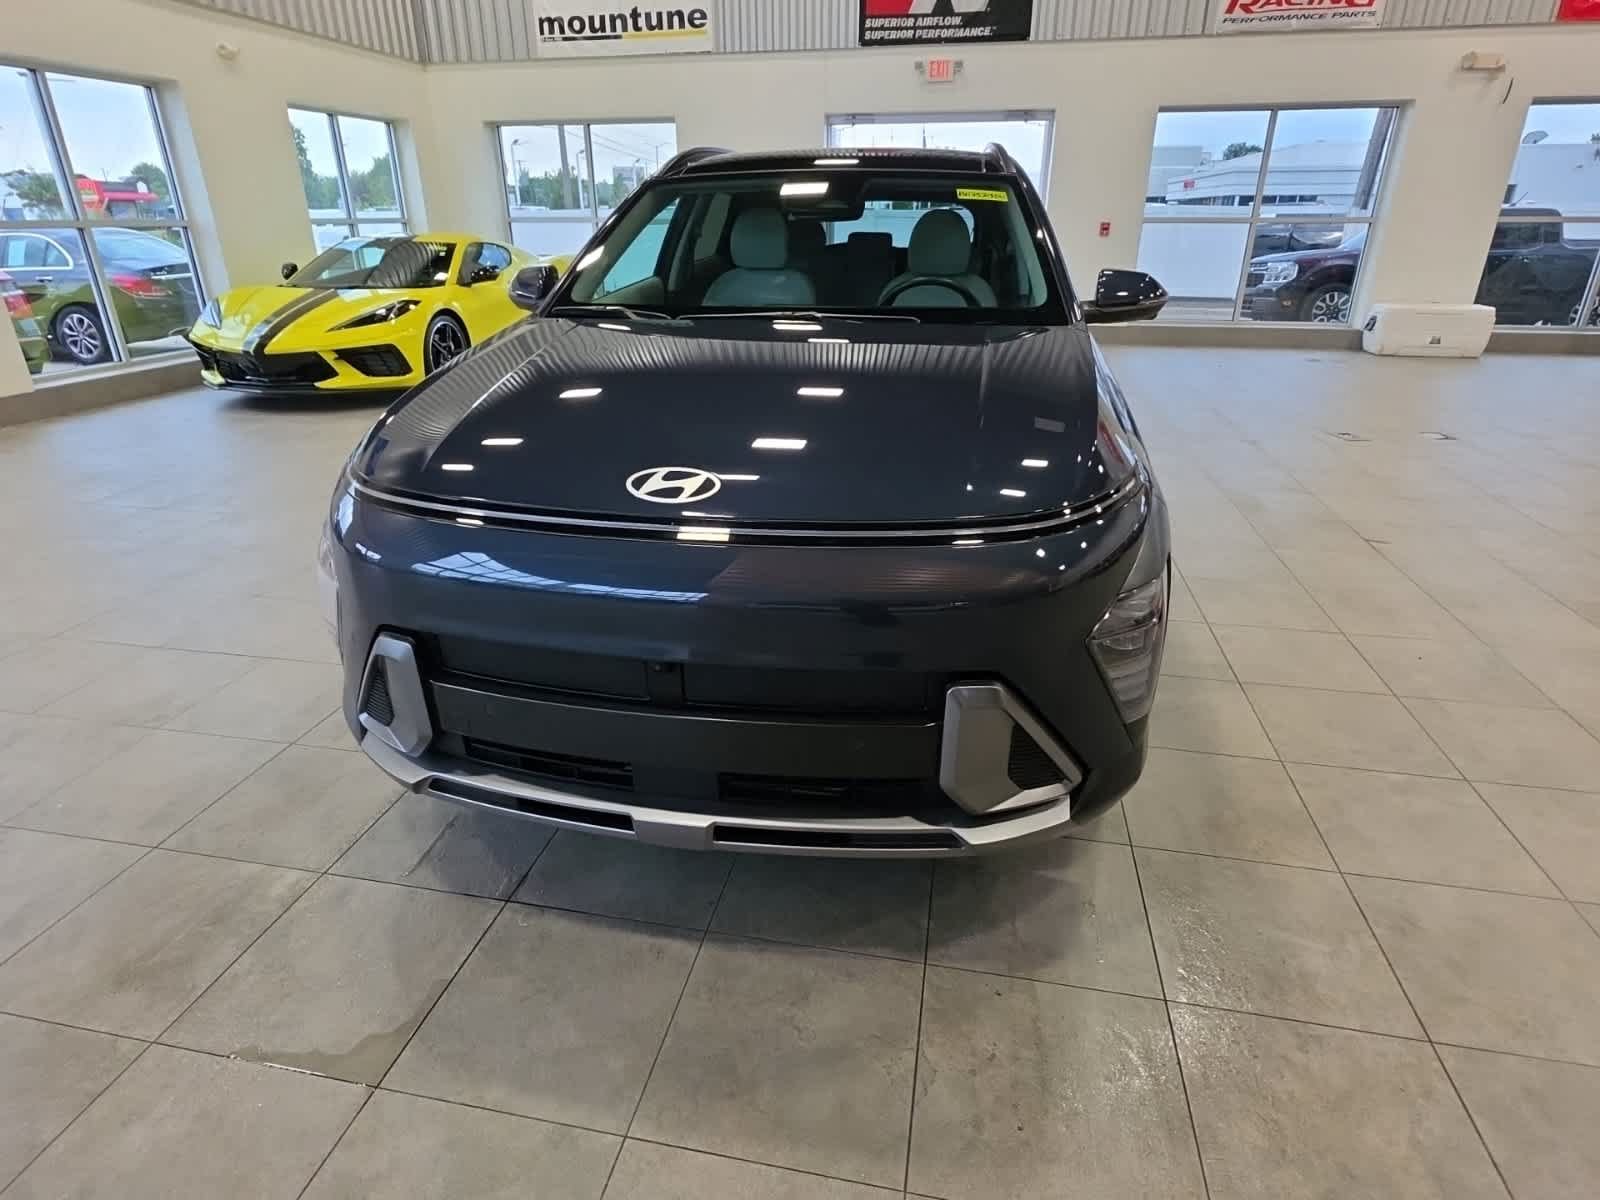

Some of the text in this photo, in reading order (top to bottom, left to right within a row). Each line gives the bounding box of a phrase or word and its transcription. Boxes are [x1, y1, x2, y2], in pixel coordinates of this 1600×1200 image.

[538, 6, 708, 36] mountune
[864, 16, 963, 28] SUPERIOR AIRFLOW.
[1222, 10, 1377, 24] PERFORMANCE PARTS
[864, 29, 914, 40] SUPERIOR
[928, 60, 951, 79] EXIT
